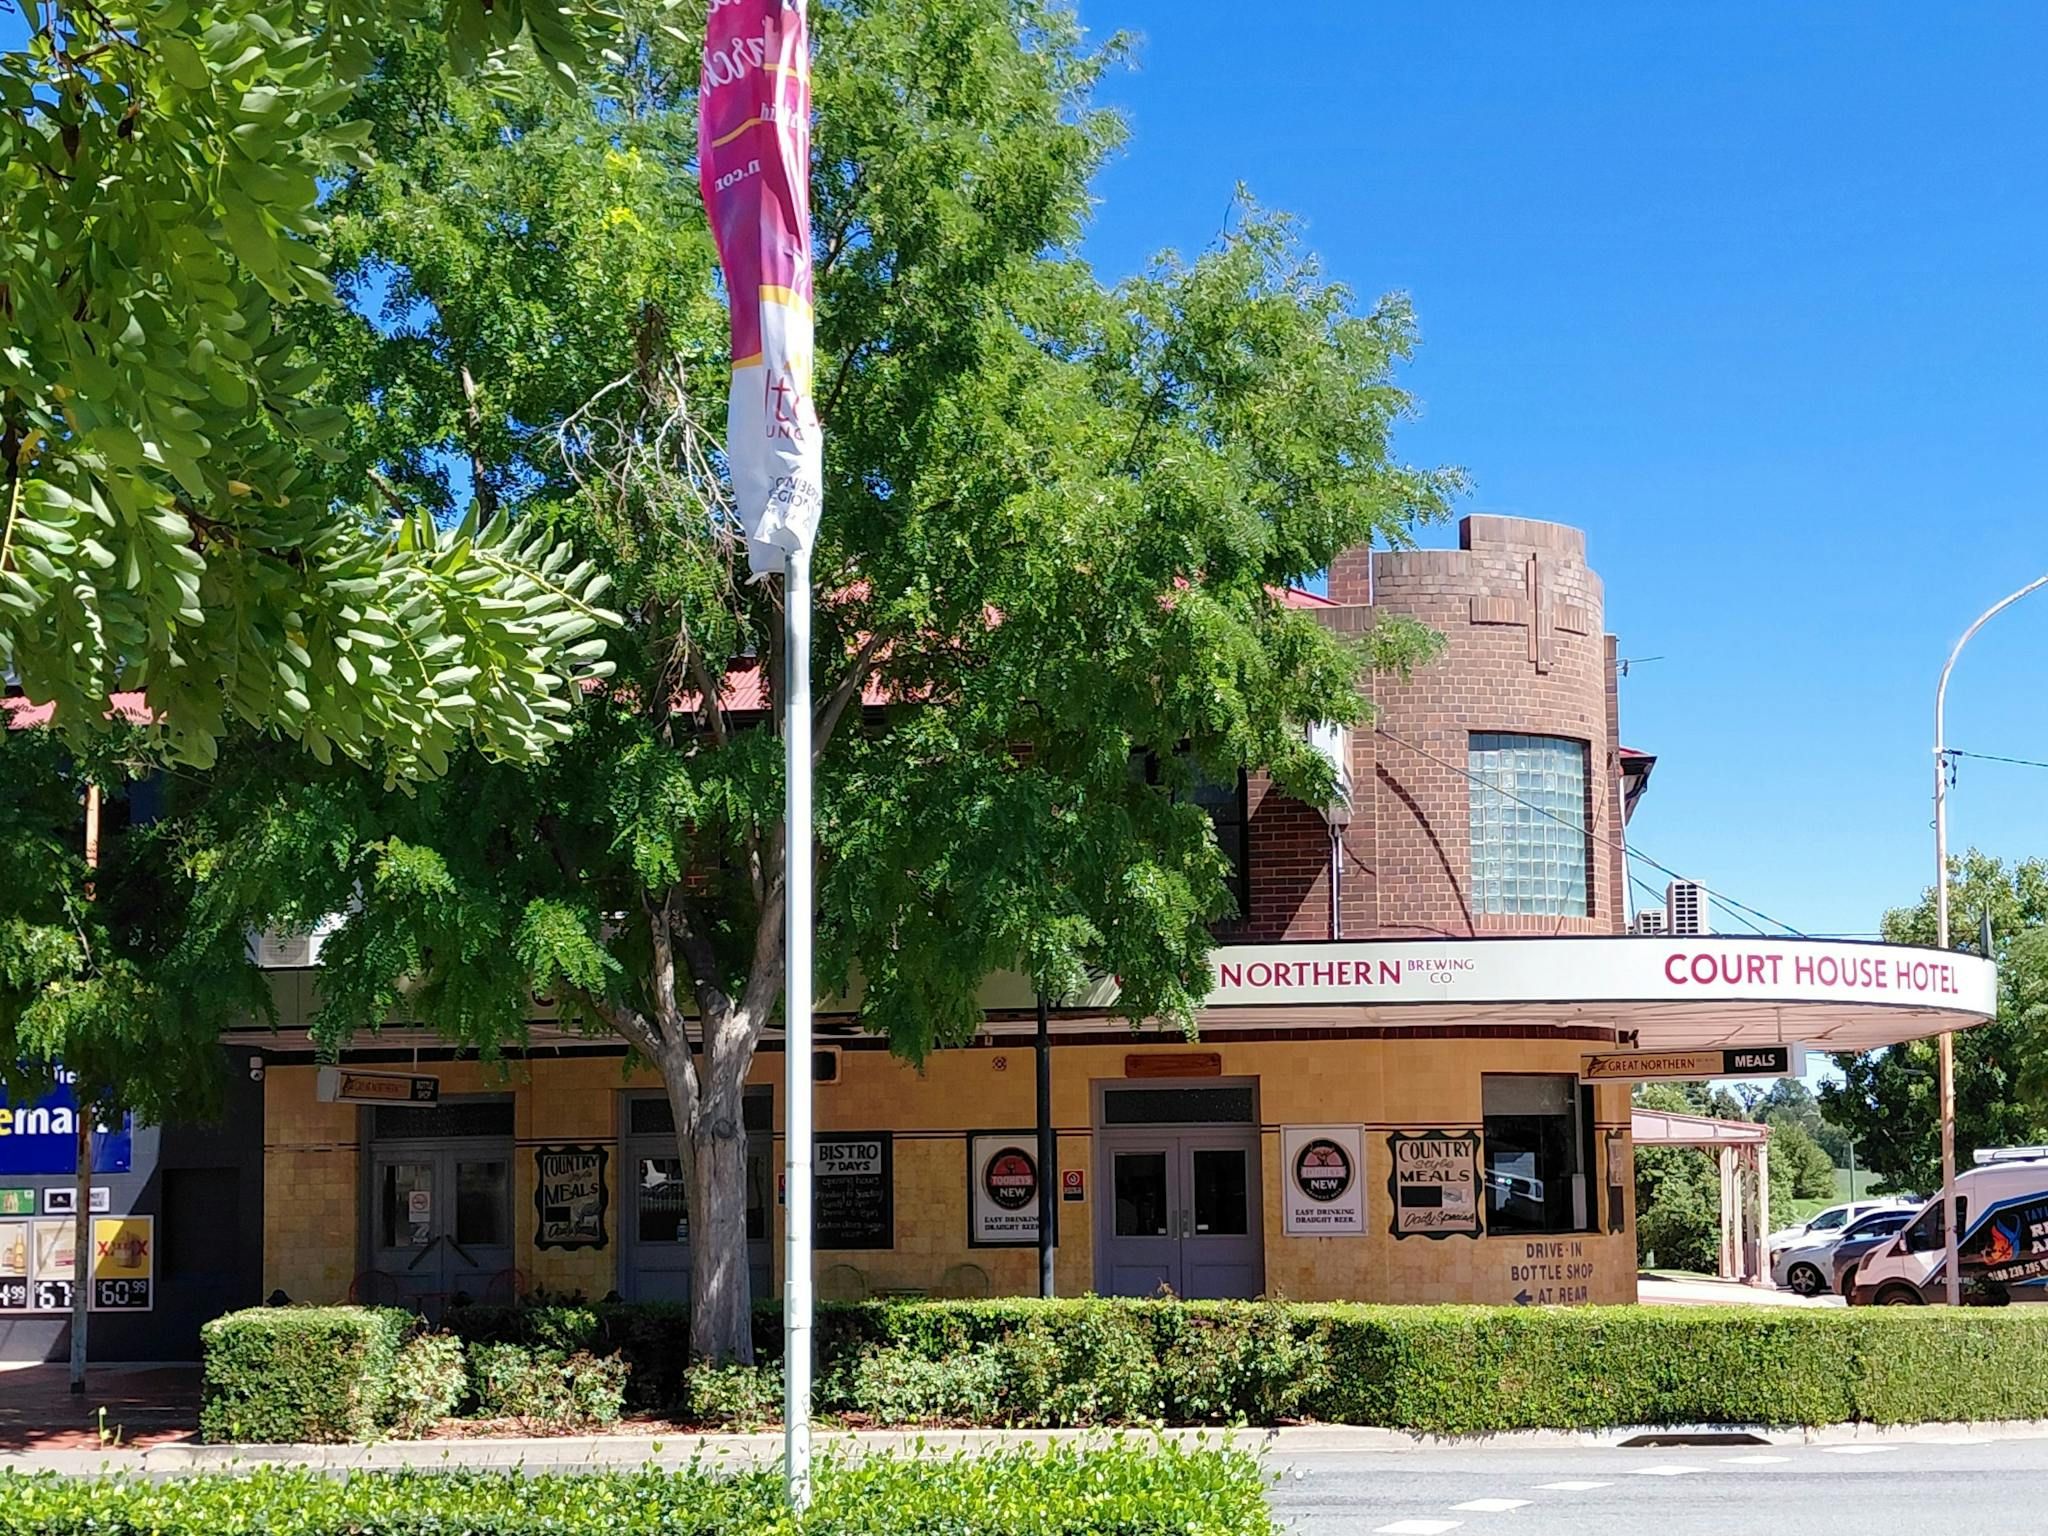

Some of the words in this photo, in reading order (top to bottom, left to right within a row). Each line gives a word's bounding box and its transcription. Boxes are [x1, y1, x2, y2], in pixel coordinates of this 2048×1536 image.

[1407, 959, 1475, 971] BREWING
[1220, 960, 1401, 988] NORTHERN
[1430, 972, 1456, 984] CO.
[1664, 953, 1784, 985] COURT
[1795, 956, 1888, 989] HOUSE
[1896, 960, 1959, 994] HOTEL
[1608, 1059, 1639, 1072] GREAT
[1641, 1058, 1695, 1071] NORTHERN
[1734, 1054, 1776, 1067] MEALS
[819, 1144, 879, 1161] BISTRO
[1399, 1141, 1472, 1163] COUNTRY
[544, 1156, 598, 1178] COUNTRY
[826, 1162, 836, 1171] 7
[838, 1161, 871, 1171] DAYS
[1400, 1169, 1471, 1182] MEALS
[1310, 1180, 1339, 1190] NEW
[544, 1183, 599, 1206] MEALS
[999, 1188, 1026, 1198] NEW
[1316, 1208, 1355, 1216] DRINKING
[984, 1216, 1003, 1224] EASY
[1511, 1265, 1563, 1281] BOTTLE
[1566, 1263, 1594, 1280] SHOP
[1538, 1288, 1553, 1304] AT
[1559, 1286, 1588, 1302] REAR
